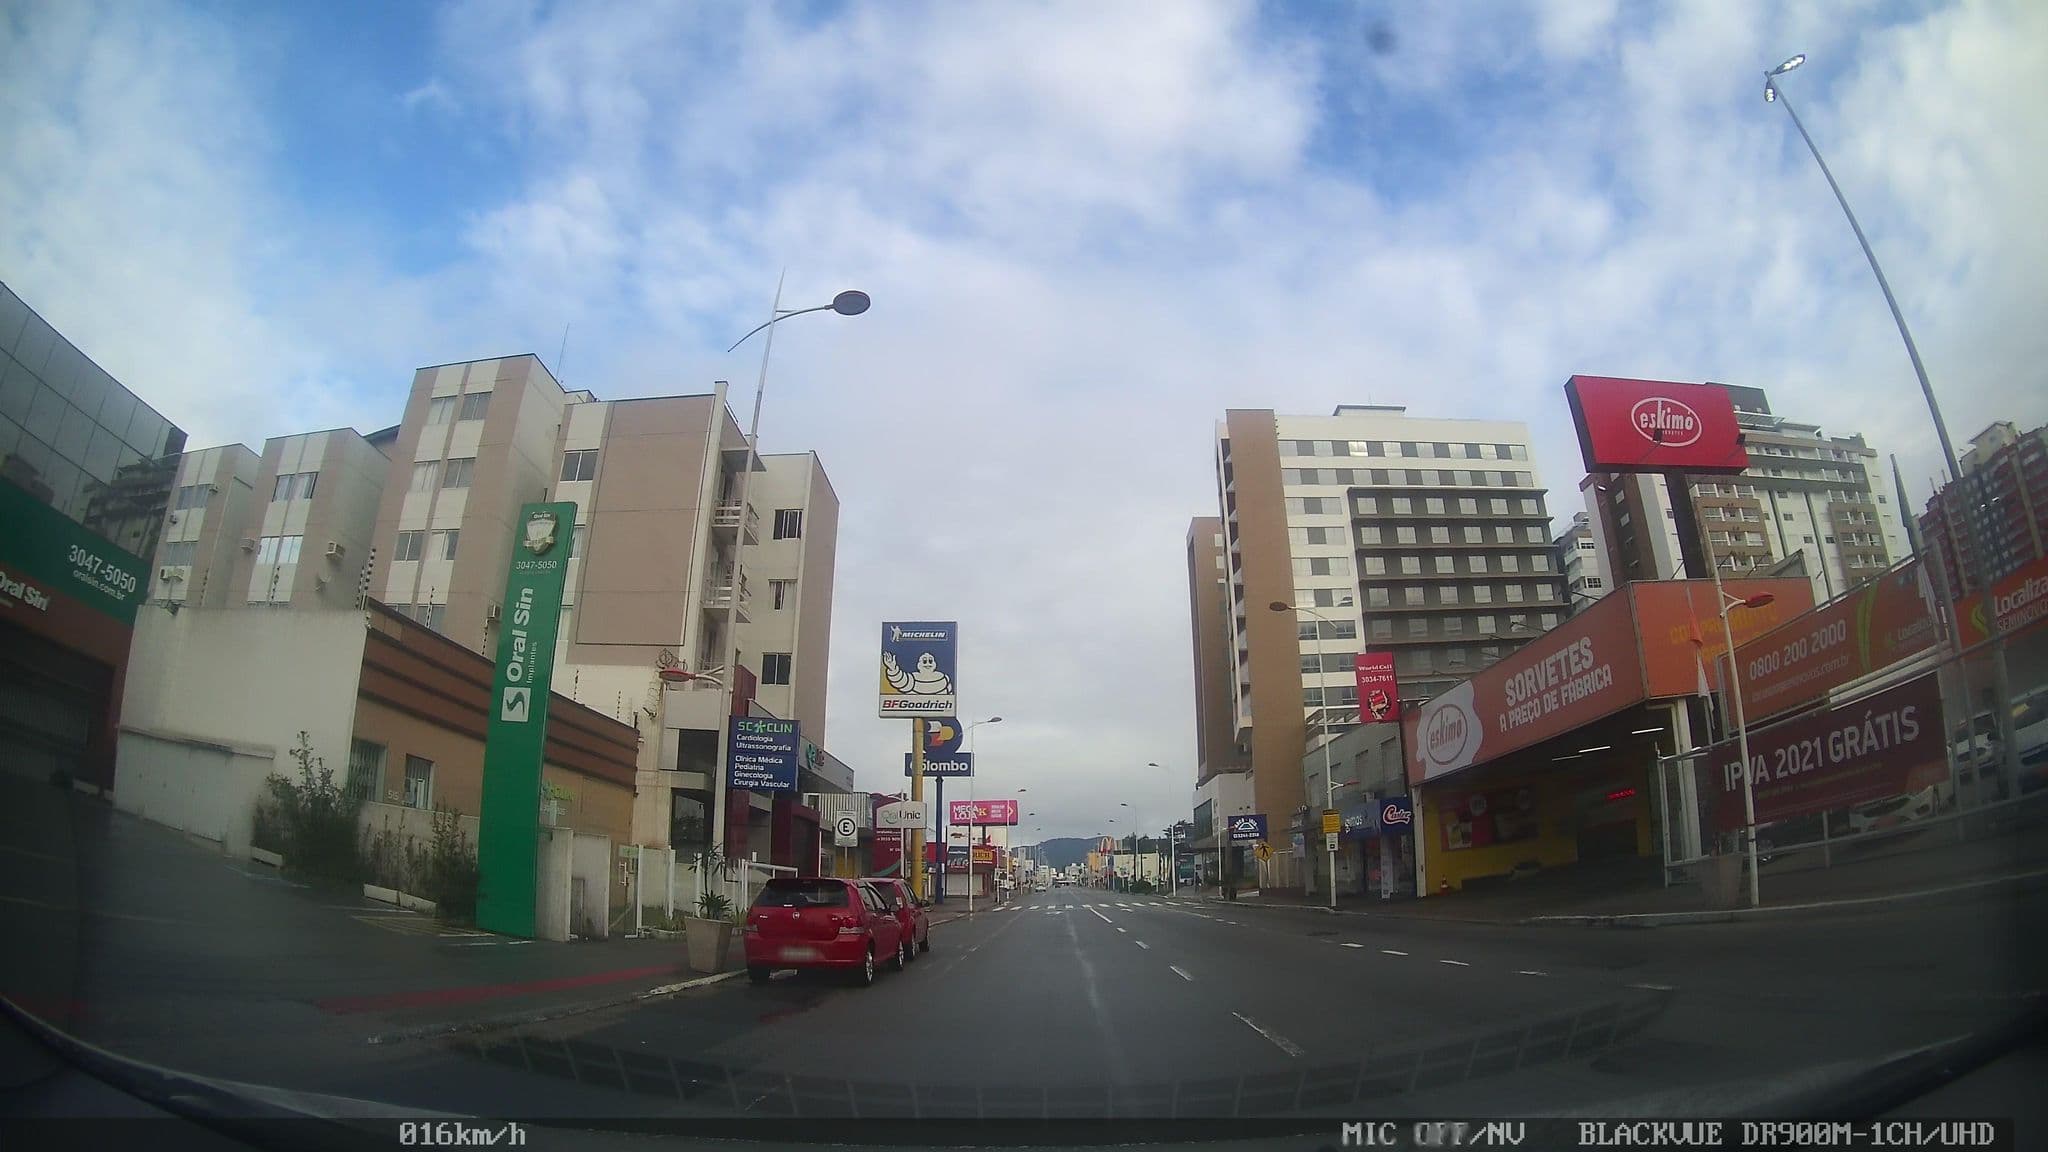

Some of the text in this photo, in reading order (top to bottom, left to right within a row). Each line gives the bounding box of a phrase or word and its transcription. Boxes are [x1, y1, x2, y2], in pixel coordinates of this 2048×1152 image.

[1640, 400, 1693, 430] eskimo
[69, 544, 136, 593] 3047-5050
[516, 560, 557, 569] 3047-5050
[1994, 575, 2048, 617] Localiza
[506, 587, 534, 682] Oral Sin
[1750, 652, 1780, 680] 0800
[1784, 638, 1808, 666] 200
[1812, 619, 1847, 652] 2000
[526, 641, 537, 684] Implantes
[1505, 636, 1594, 706] SORVETES
[883, 700, 953, 709] BFGoodrich
[1500, 663, 1613, 732] A PREÇO DE FÁBRICA
[736, 734, 773, 743] Cardiologia
[1430, 710, 1463, 747] eskimo
[1775, 736, 1823, 779] 2021
[1828, 705, 1920, 764] GRÁTIS
[736, 742, 792, 752] Ultrassonografia
[734, 771, 773, 780] Ginecologia
[735, 763, 764, 771] Pediatria
[909, 760, 969, 771] olombo
[734, 779, 790, 788] Cirurgia Vascular
[842, 822, 850, 832] E
